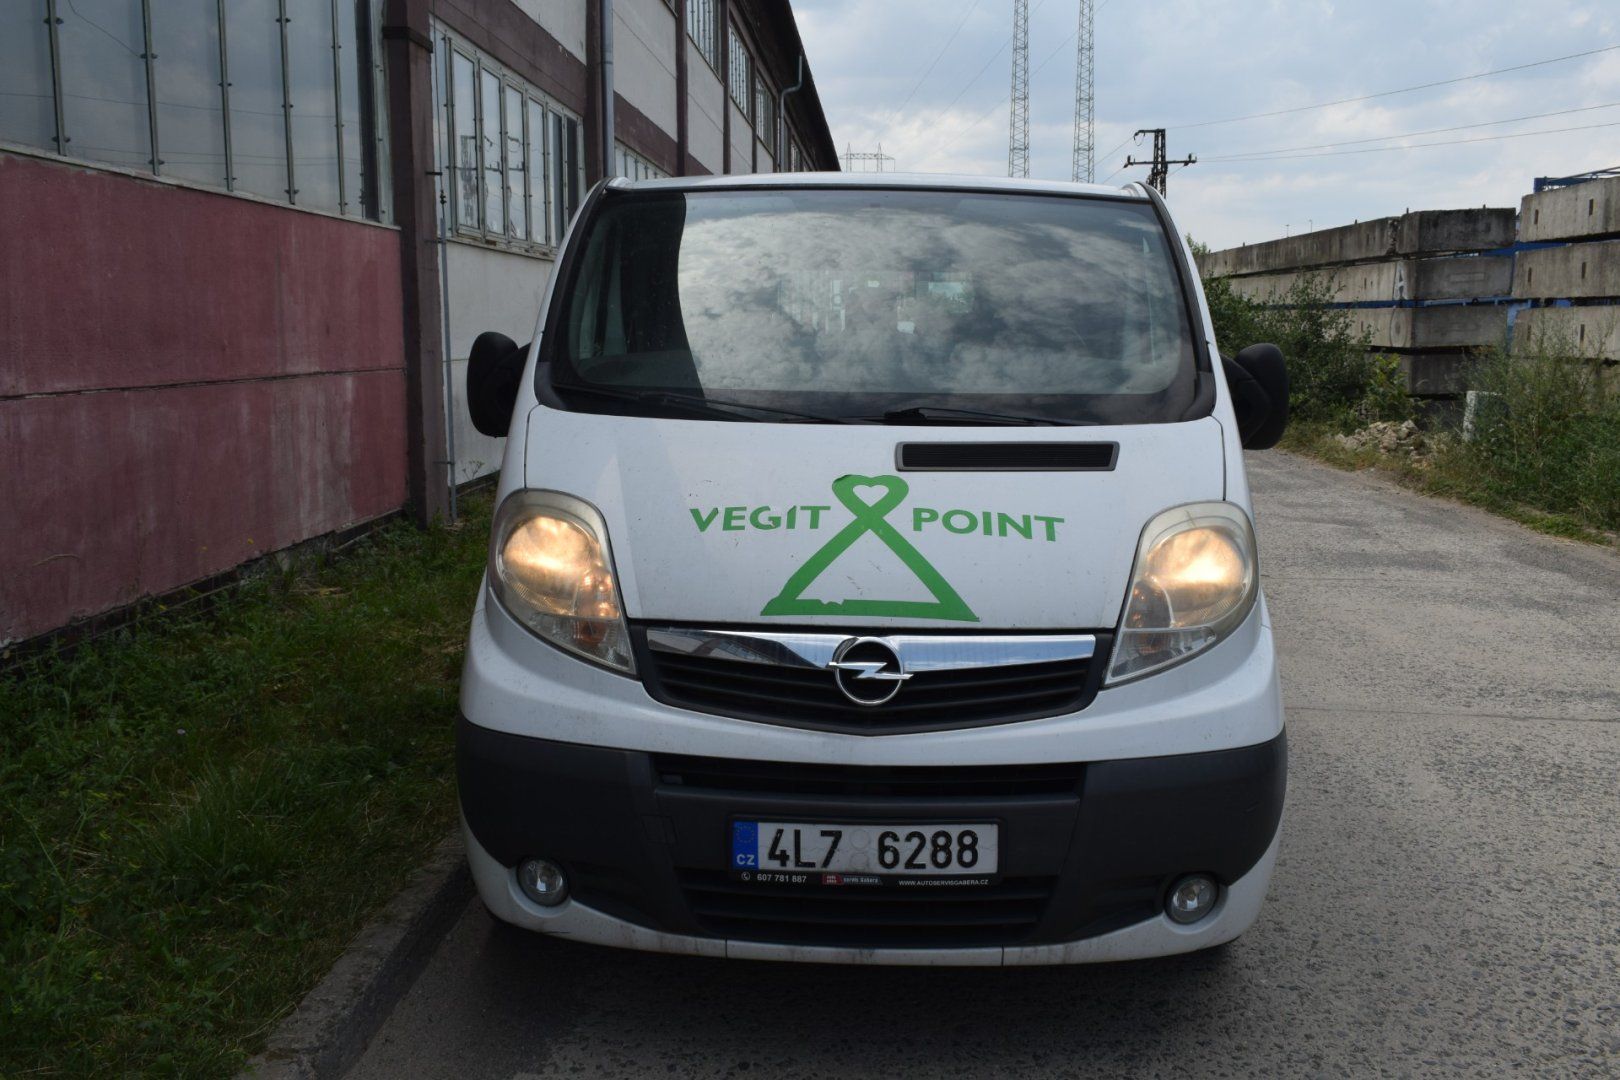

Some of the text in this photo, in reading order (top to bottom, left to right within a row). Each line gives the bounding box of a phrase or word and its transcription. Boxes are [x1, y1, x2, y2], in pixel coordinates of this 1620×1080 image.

[689, 505, 1065, 542] VEGIT POINT
[736, 853, 755, 866] CZ
[767, 828, 979, 870] 4L7 6288
[774, 874, 789, 882] 781
